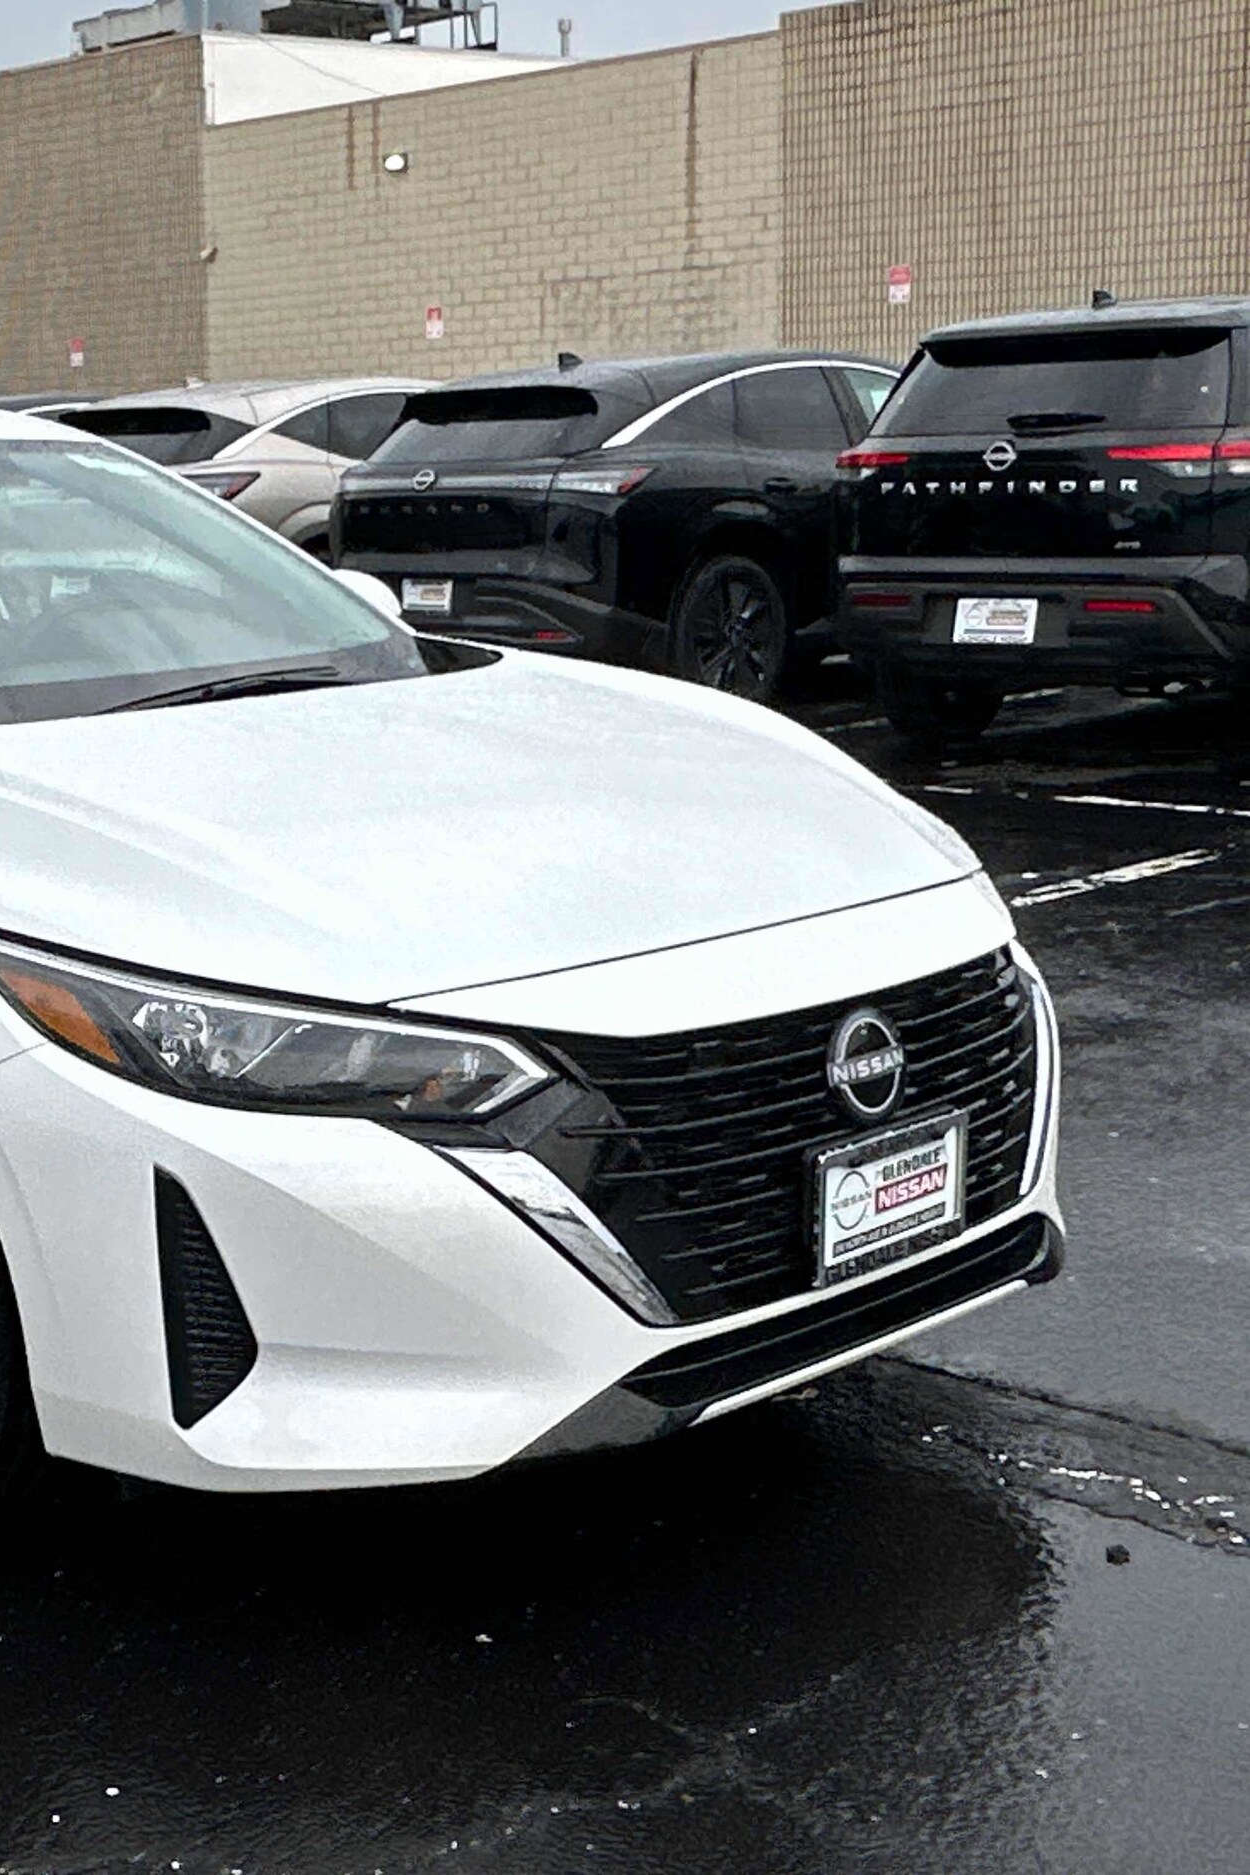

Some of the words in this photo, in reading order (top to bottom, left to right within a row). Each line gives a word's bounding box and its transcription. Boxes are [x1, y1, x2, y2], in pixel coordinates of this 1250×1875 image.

[880, 478, 1139, 496] PATHFINDER
[831, 1048, 904, 1084] NISSAN
[877, 1168, 945, 1211] NISSAN
